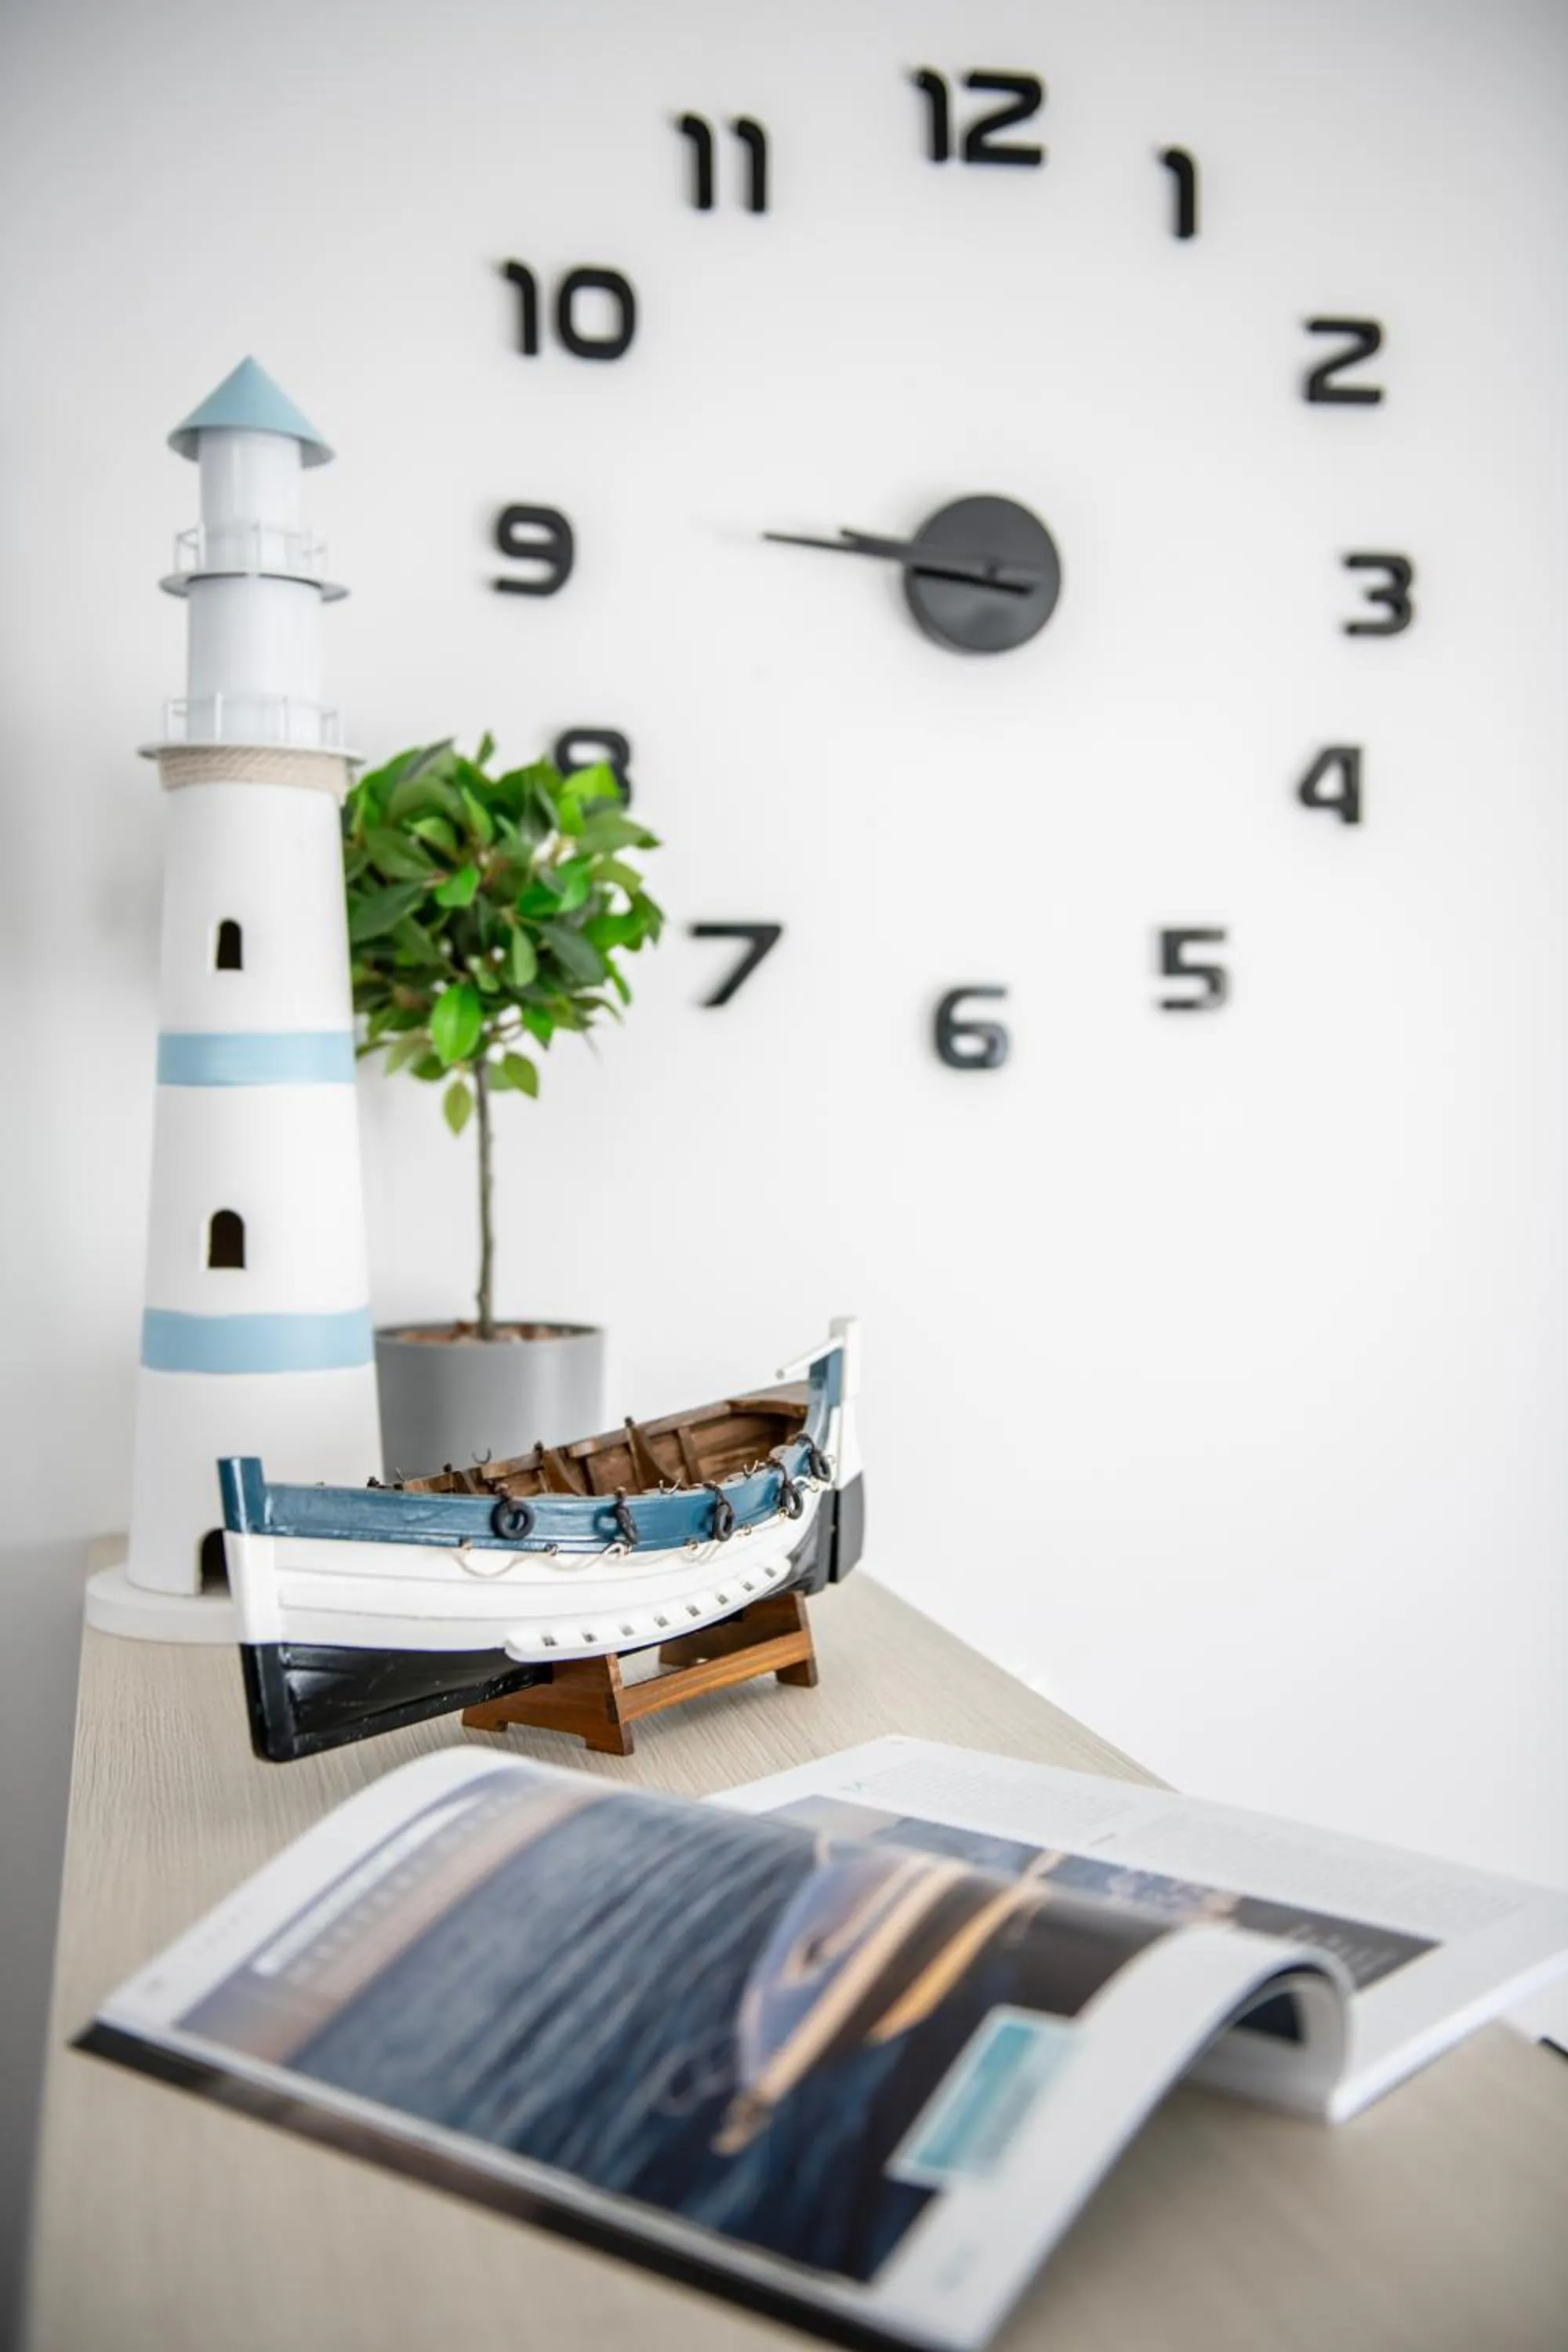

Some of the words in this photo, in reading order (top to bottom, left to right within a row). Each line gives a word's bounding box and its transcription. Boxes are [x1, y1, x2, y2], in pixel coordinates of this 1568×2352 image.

[910, 67, 1045, 168] 12
[674, 113, 768, 215] 11
[1158, 147, 1197, 241] 1
[499, 260, 637, 362] 10
[1302, 318, 1383, 406] 2
[492, 503, 575, 597] 9
[1344, 554, 1414, 637] 3
[1298, 746, 1361, 825] 4
[689, 923, 782, 1007] 7
[1159, 929, 1227, 1011] 5
[933, 988, 1007, 1070] 6
